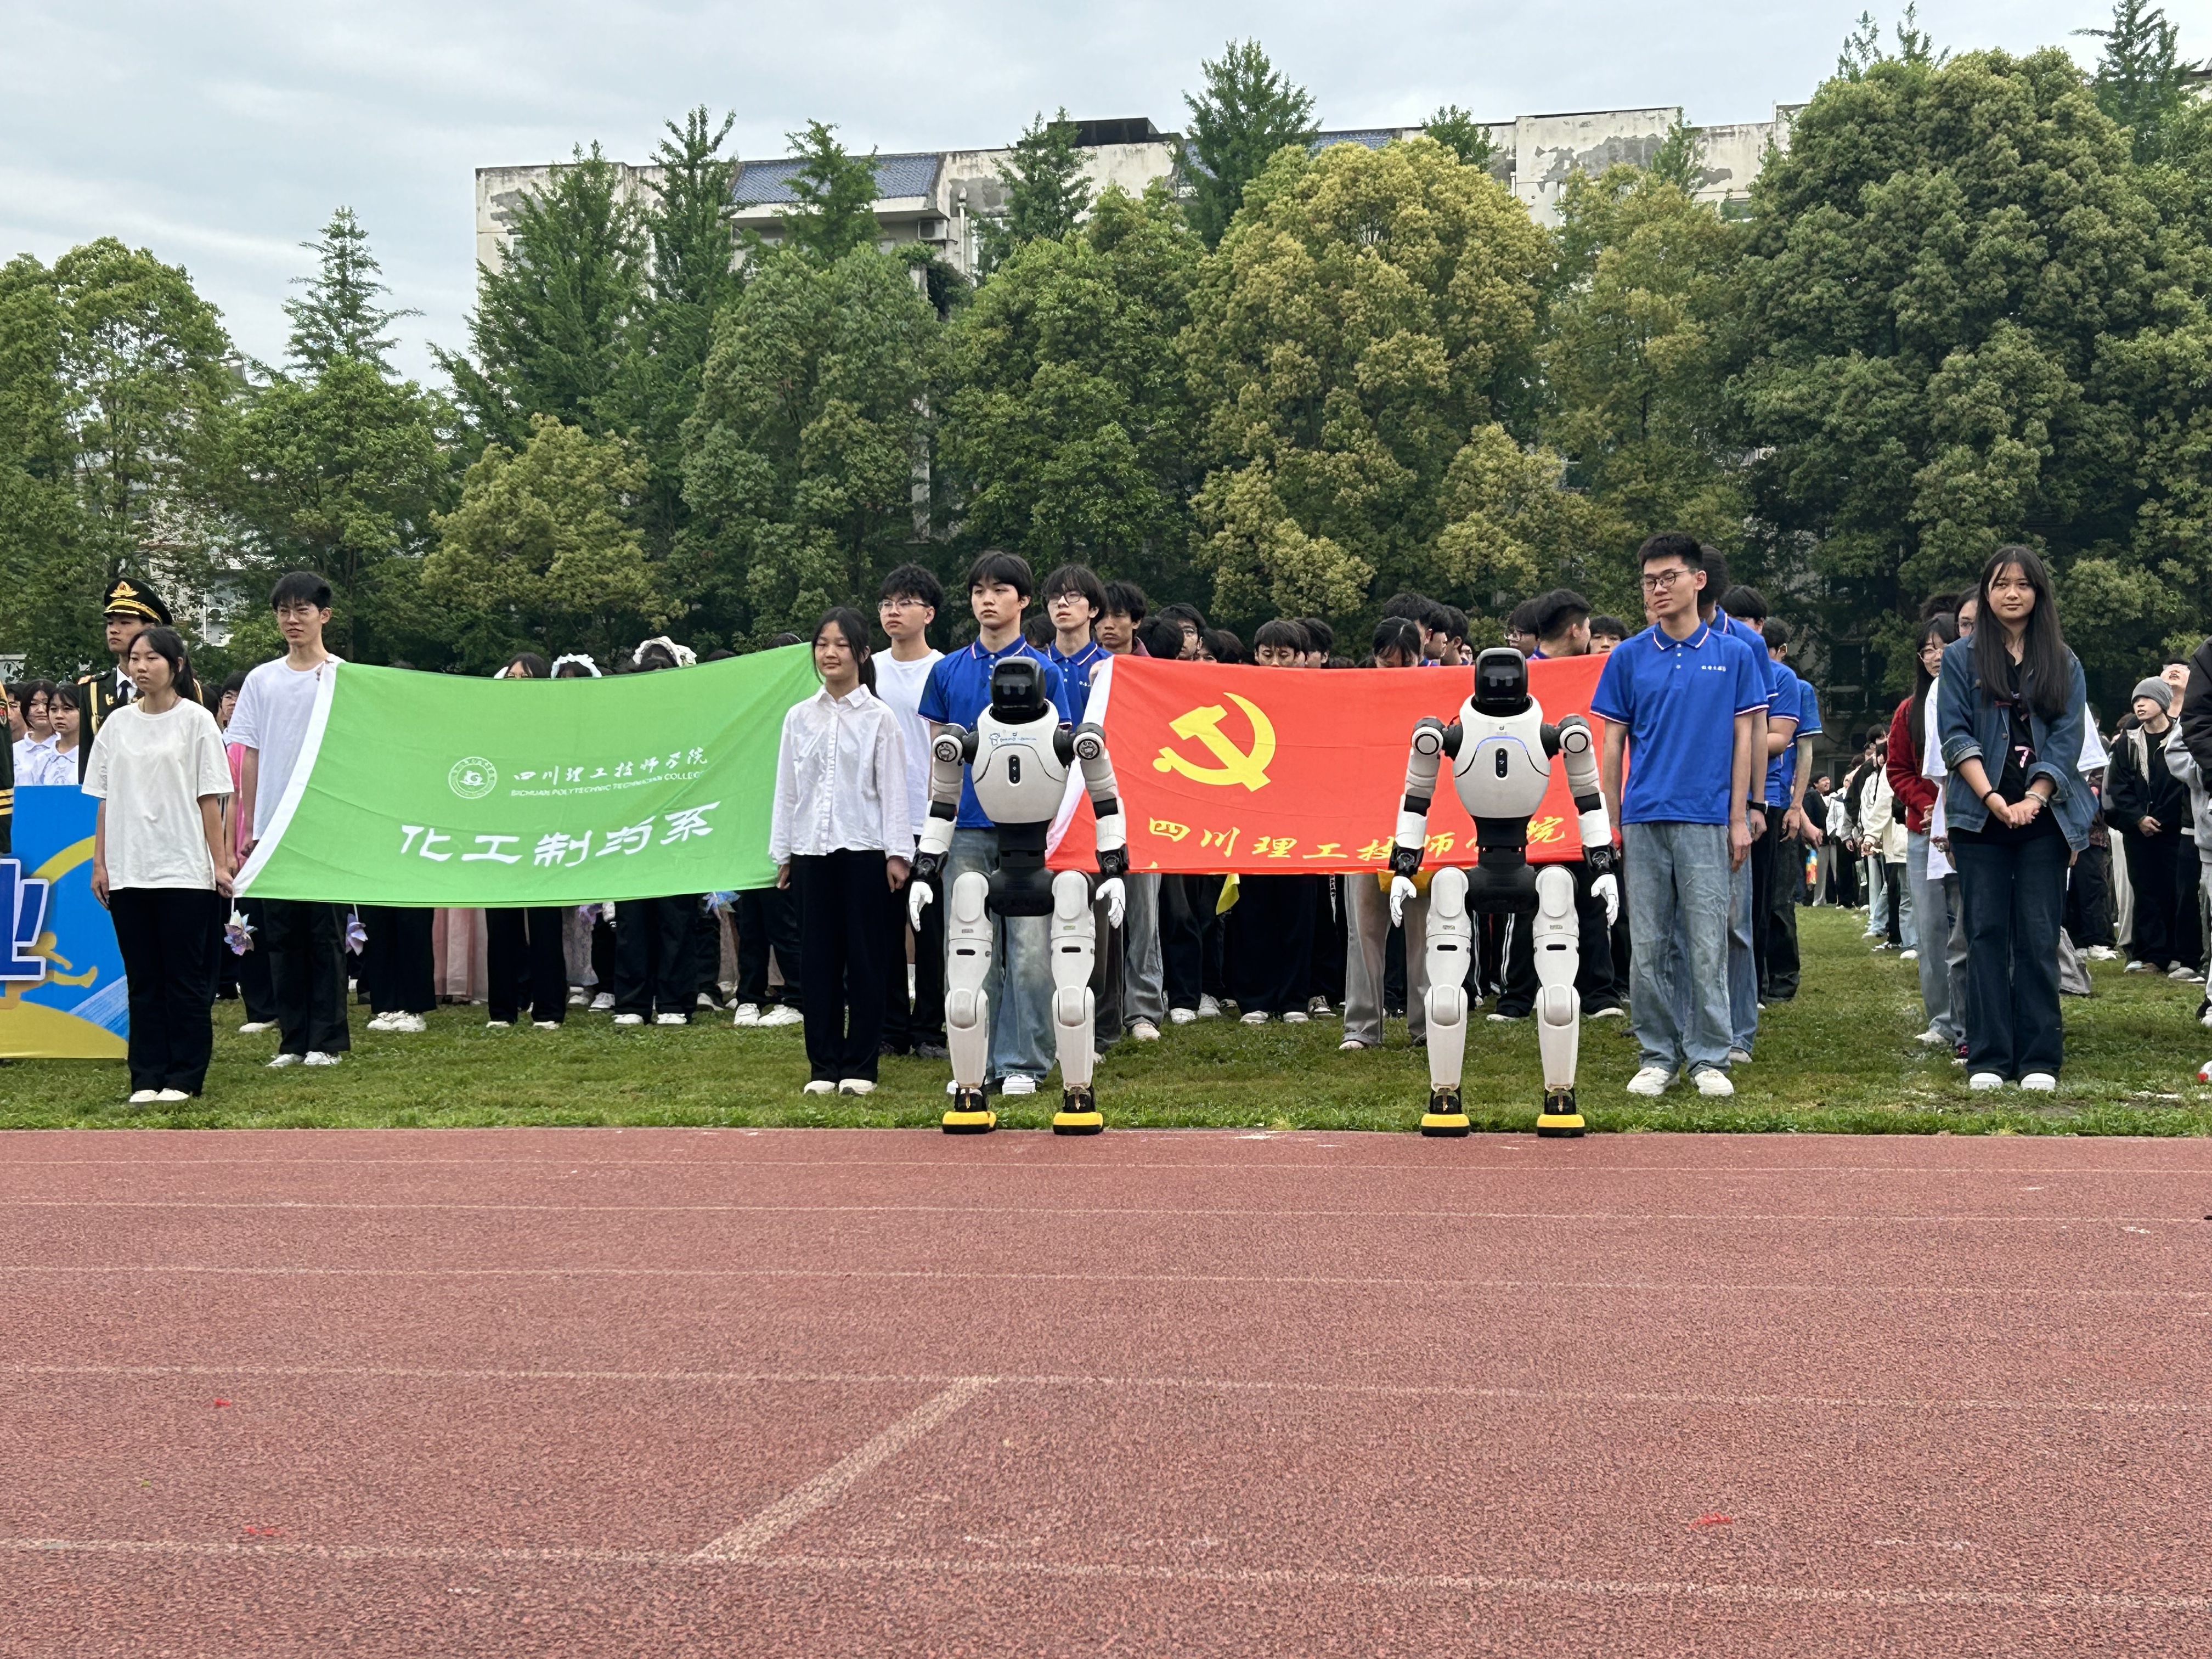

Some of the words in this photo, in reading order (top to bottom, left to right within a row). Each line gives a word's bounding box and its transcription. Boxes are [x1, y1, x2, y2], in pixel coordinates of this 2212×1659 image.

[514, 747, 708, 786] 四川理工技师学院
[664, 770, 704, 781] COLLEG
[400, 800, 721, 867] 化工制药系
[1149, 816, 1565, 861] 四川理工技师院
